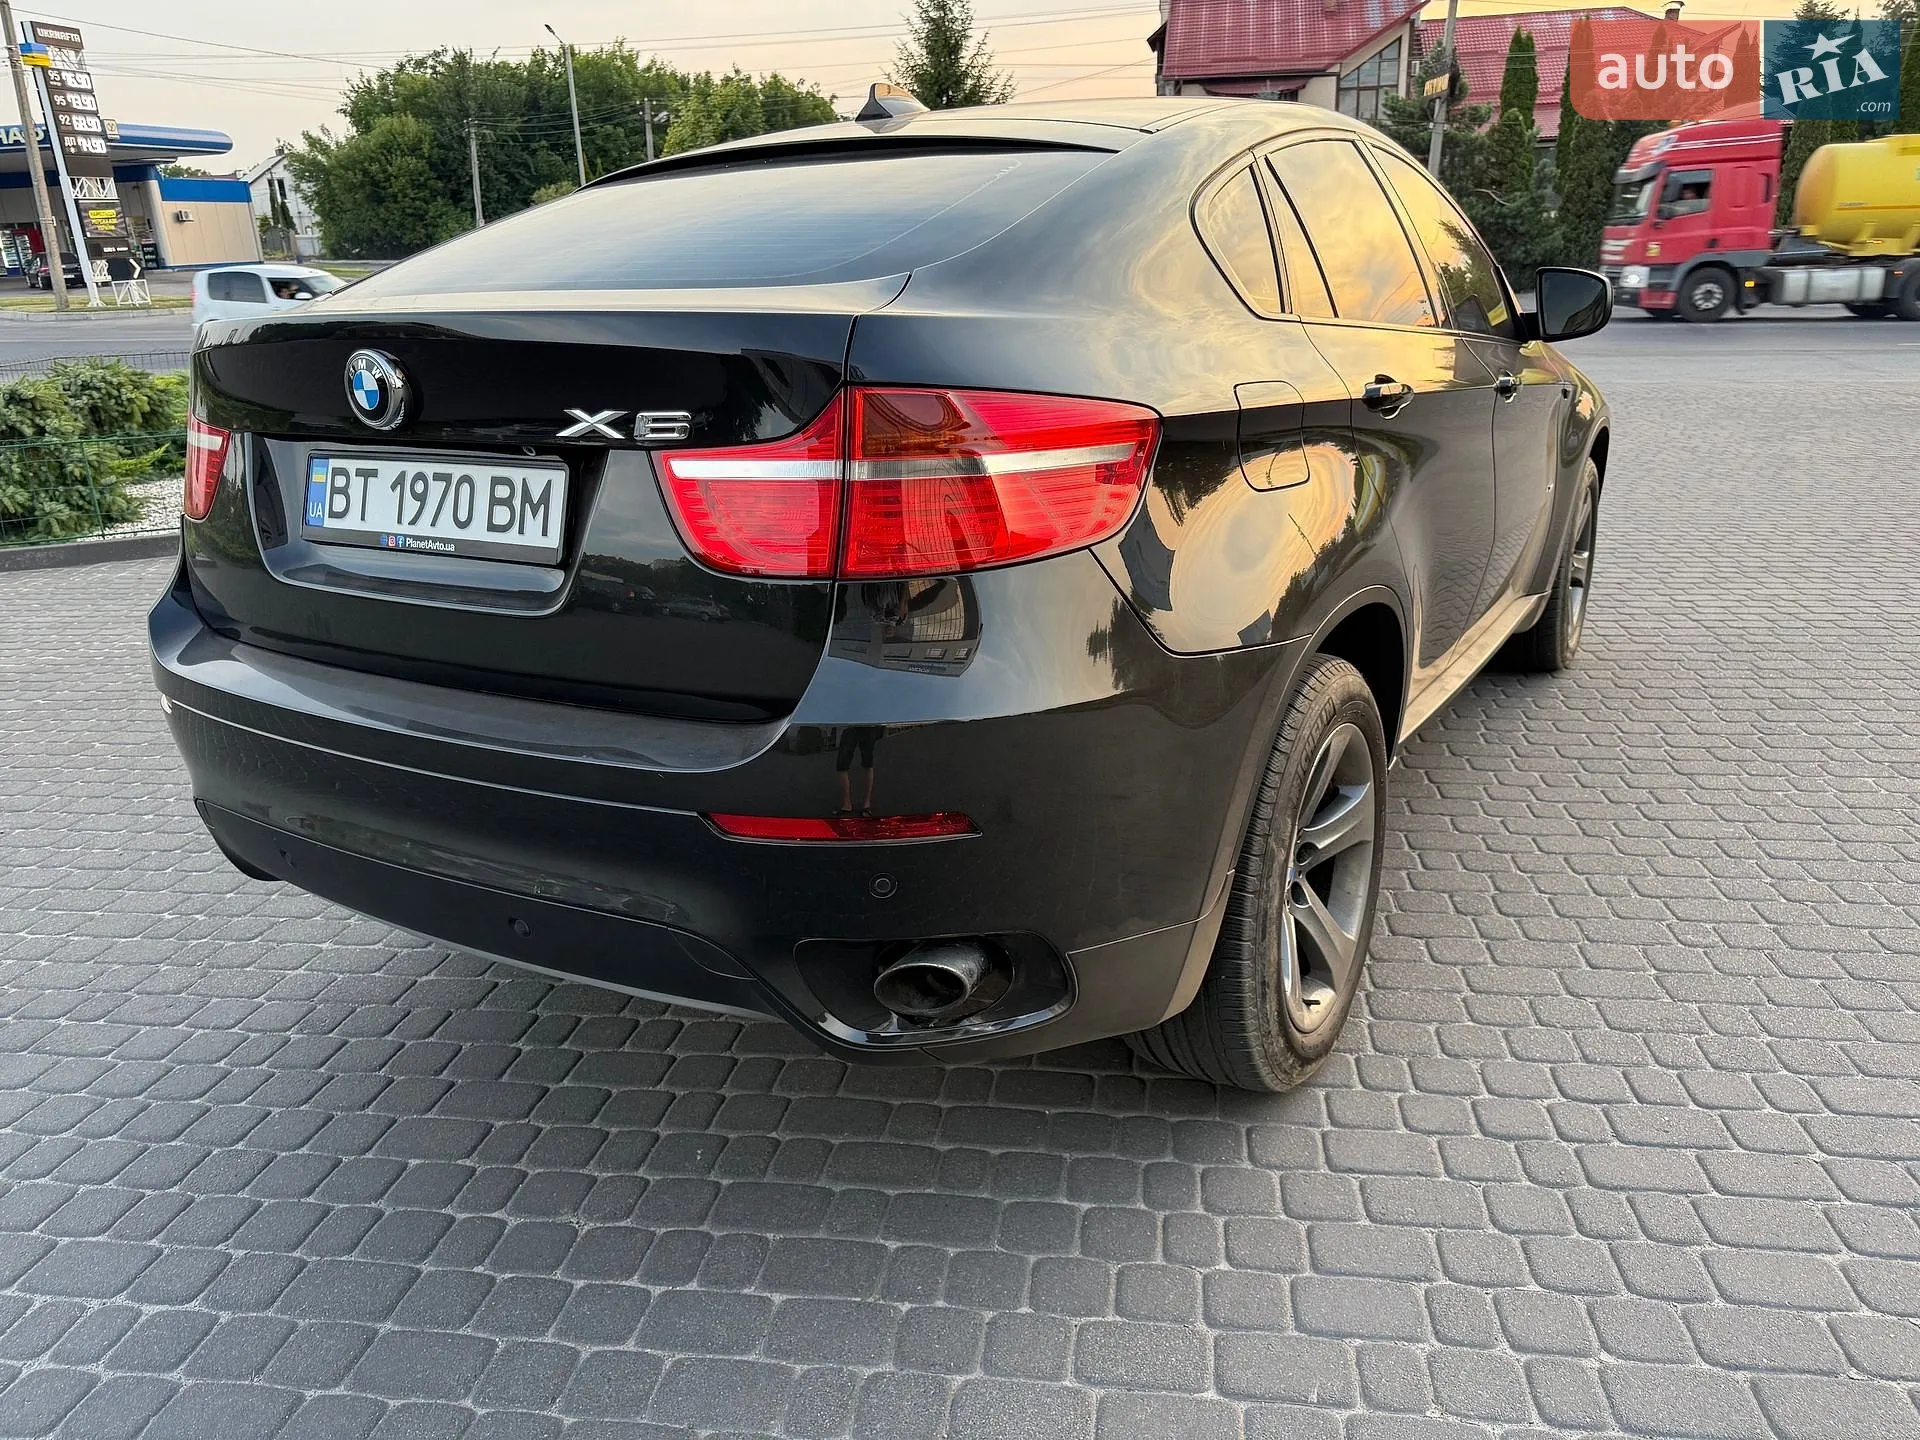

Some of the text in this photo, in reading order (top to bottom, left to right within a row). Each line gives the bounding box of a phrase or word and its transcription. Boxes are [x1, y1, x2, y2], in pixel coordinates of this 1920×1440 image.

[48, 70, 60, 80] 95
[54, 95, 66, 105] 95
[59, 115, 71, 125] 92
[349, 359, 383, 380] BMW
[556, 409, 692, 440] X6
[309, 467, 551, 536] UA BT 1970 BM
[406, 538, 455, 551] PlanetAvto.ua
